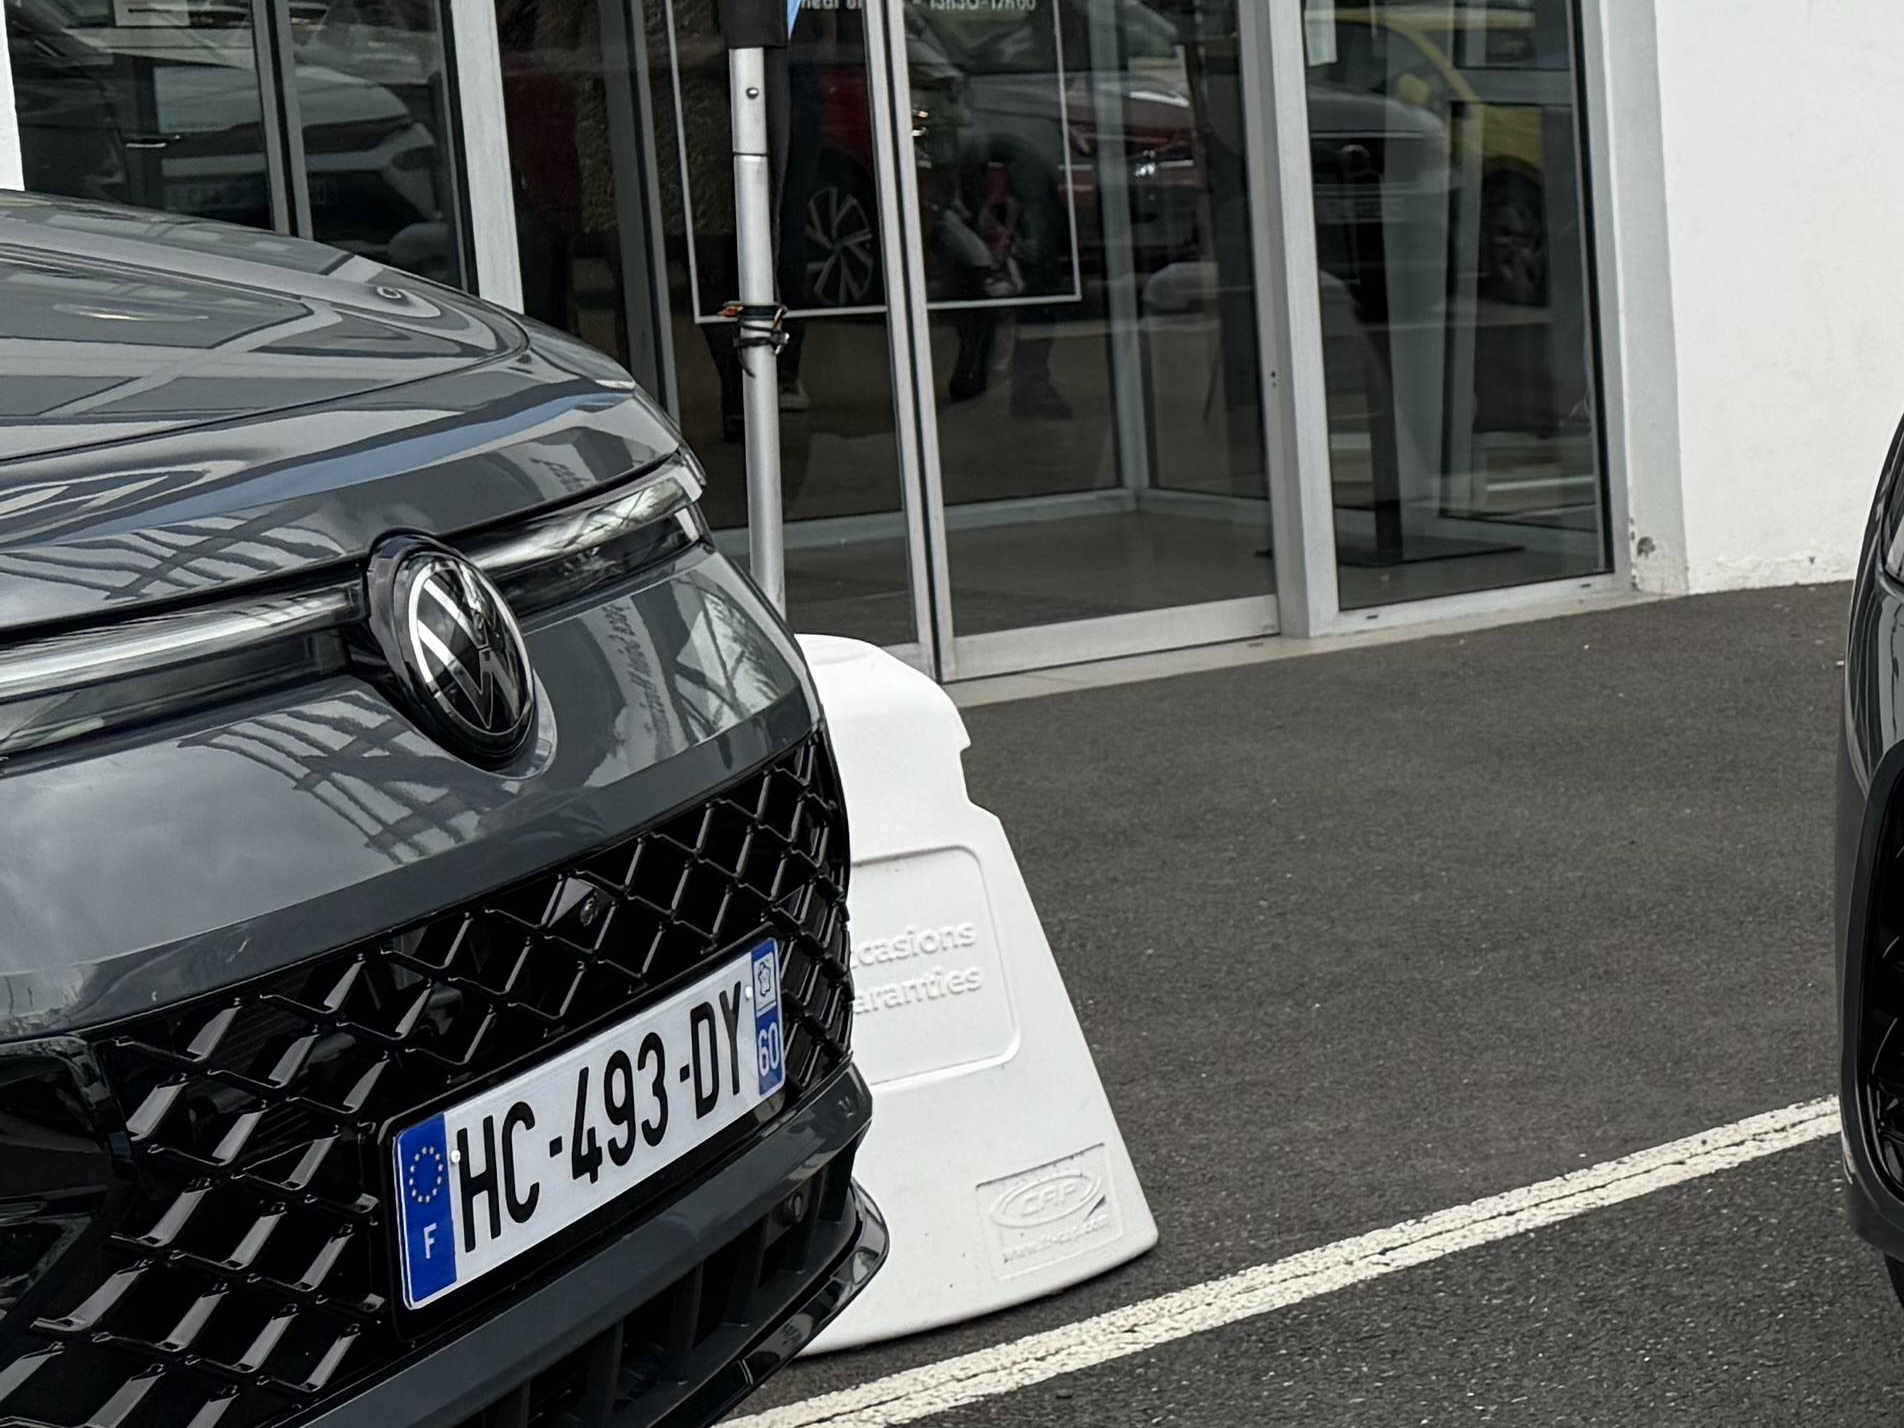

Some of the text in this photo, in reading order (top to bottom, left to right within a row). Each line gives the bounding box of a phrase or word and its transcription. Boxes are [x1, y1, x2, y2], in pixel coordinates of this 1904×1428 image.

[850, 922, 976, 970] casions
[853, 966, 983, 1015] aranties
[757, 1020, 781, 1078] 60
[456, 980, 742, 1254] HC-493-DY
[423, 1223, 437, 1260] F
